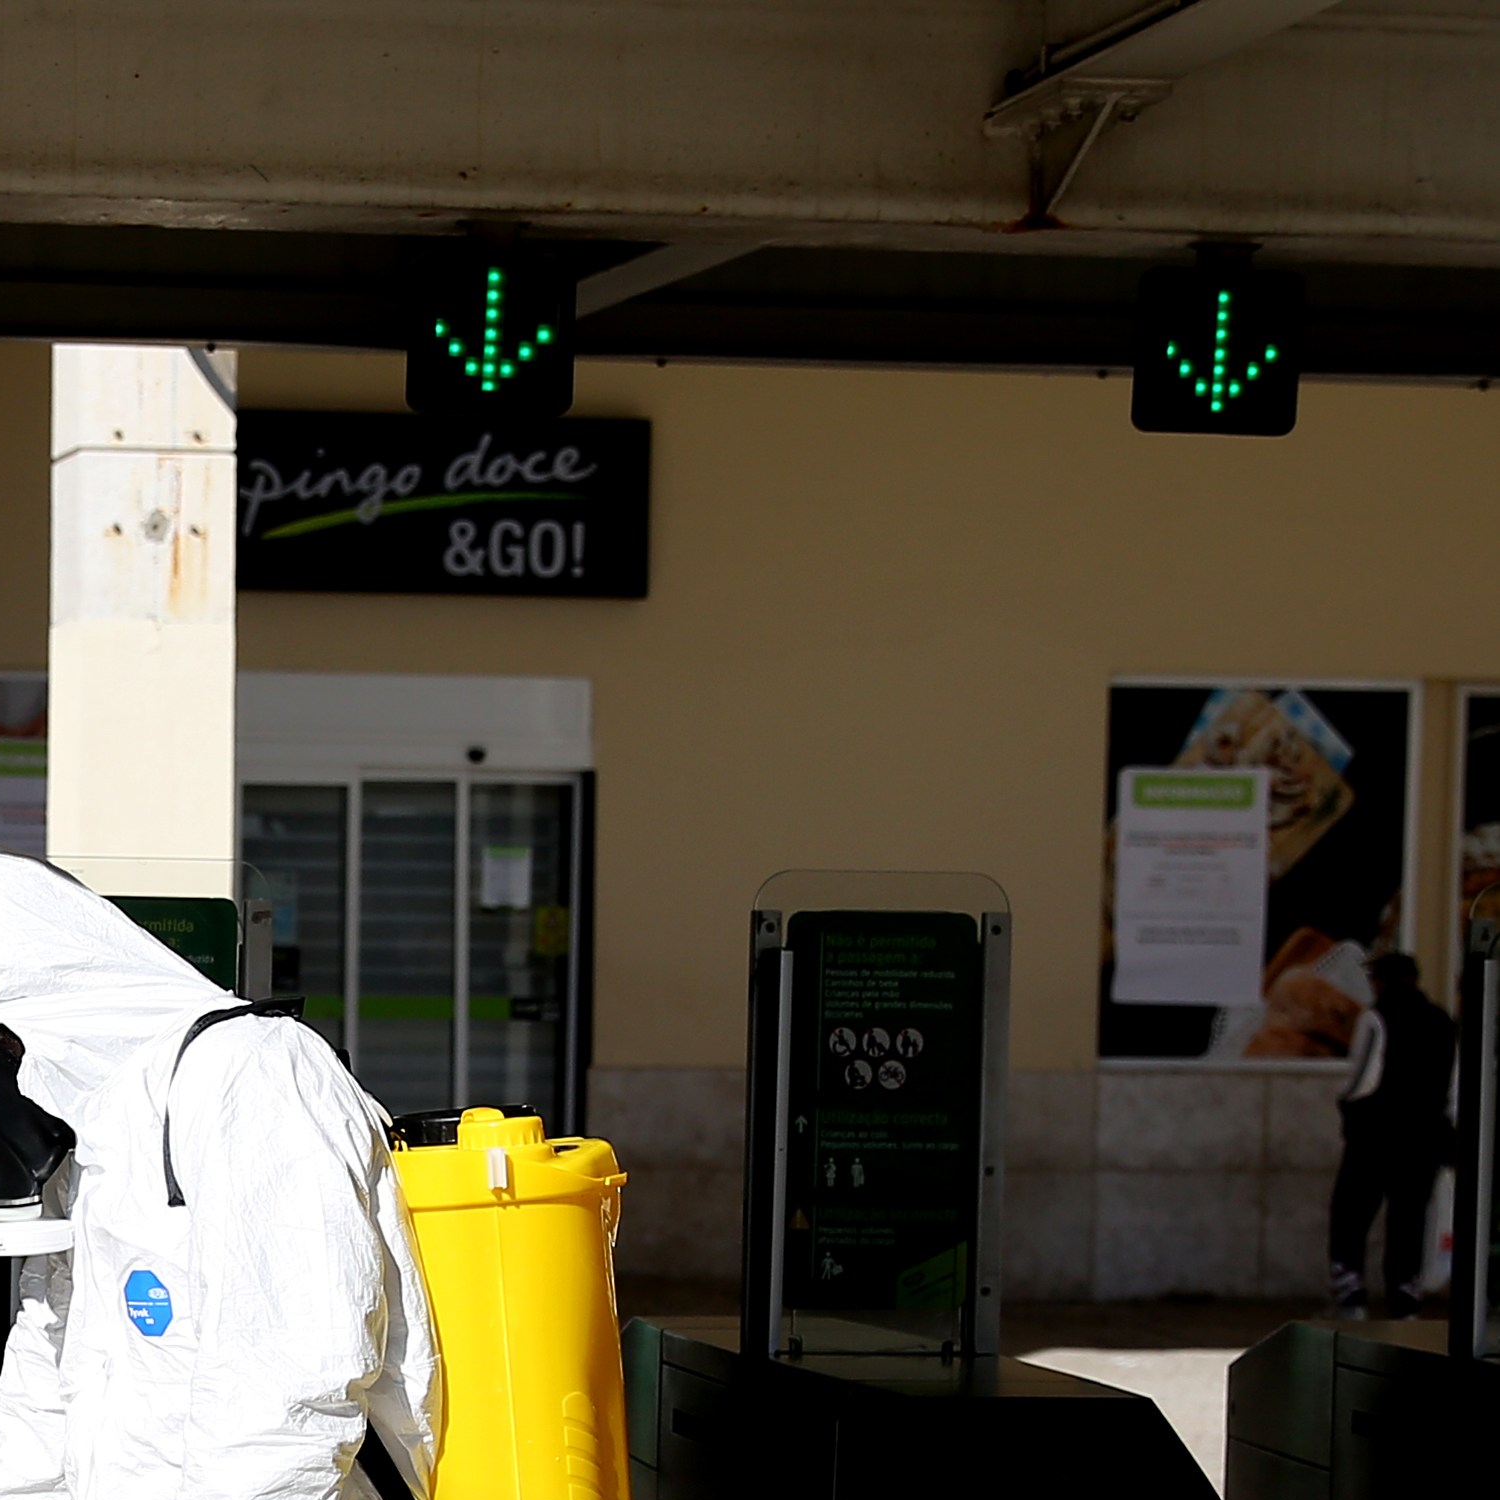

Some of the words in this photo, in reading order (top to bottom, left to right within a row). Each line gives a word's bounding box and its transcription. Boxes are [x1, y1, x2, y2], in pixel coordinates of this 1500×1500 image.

[239, 444, 422, 540] pingo
[443, 430, 599, 491] doce
[443, 517, 587, 579] &GO!
[870, 935, 937, 949] permitida
[838, 952, 906, 966] passagem
[893, 1112, 949, 1126] correcta
